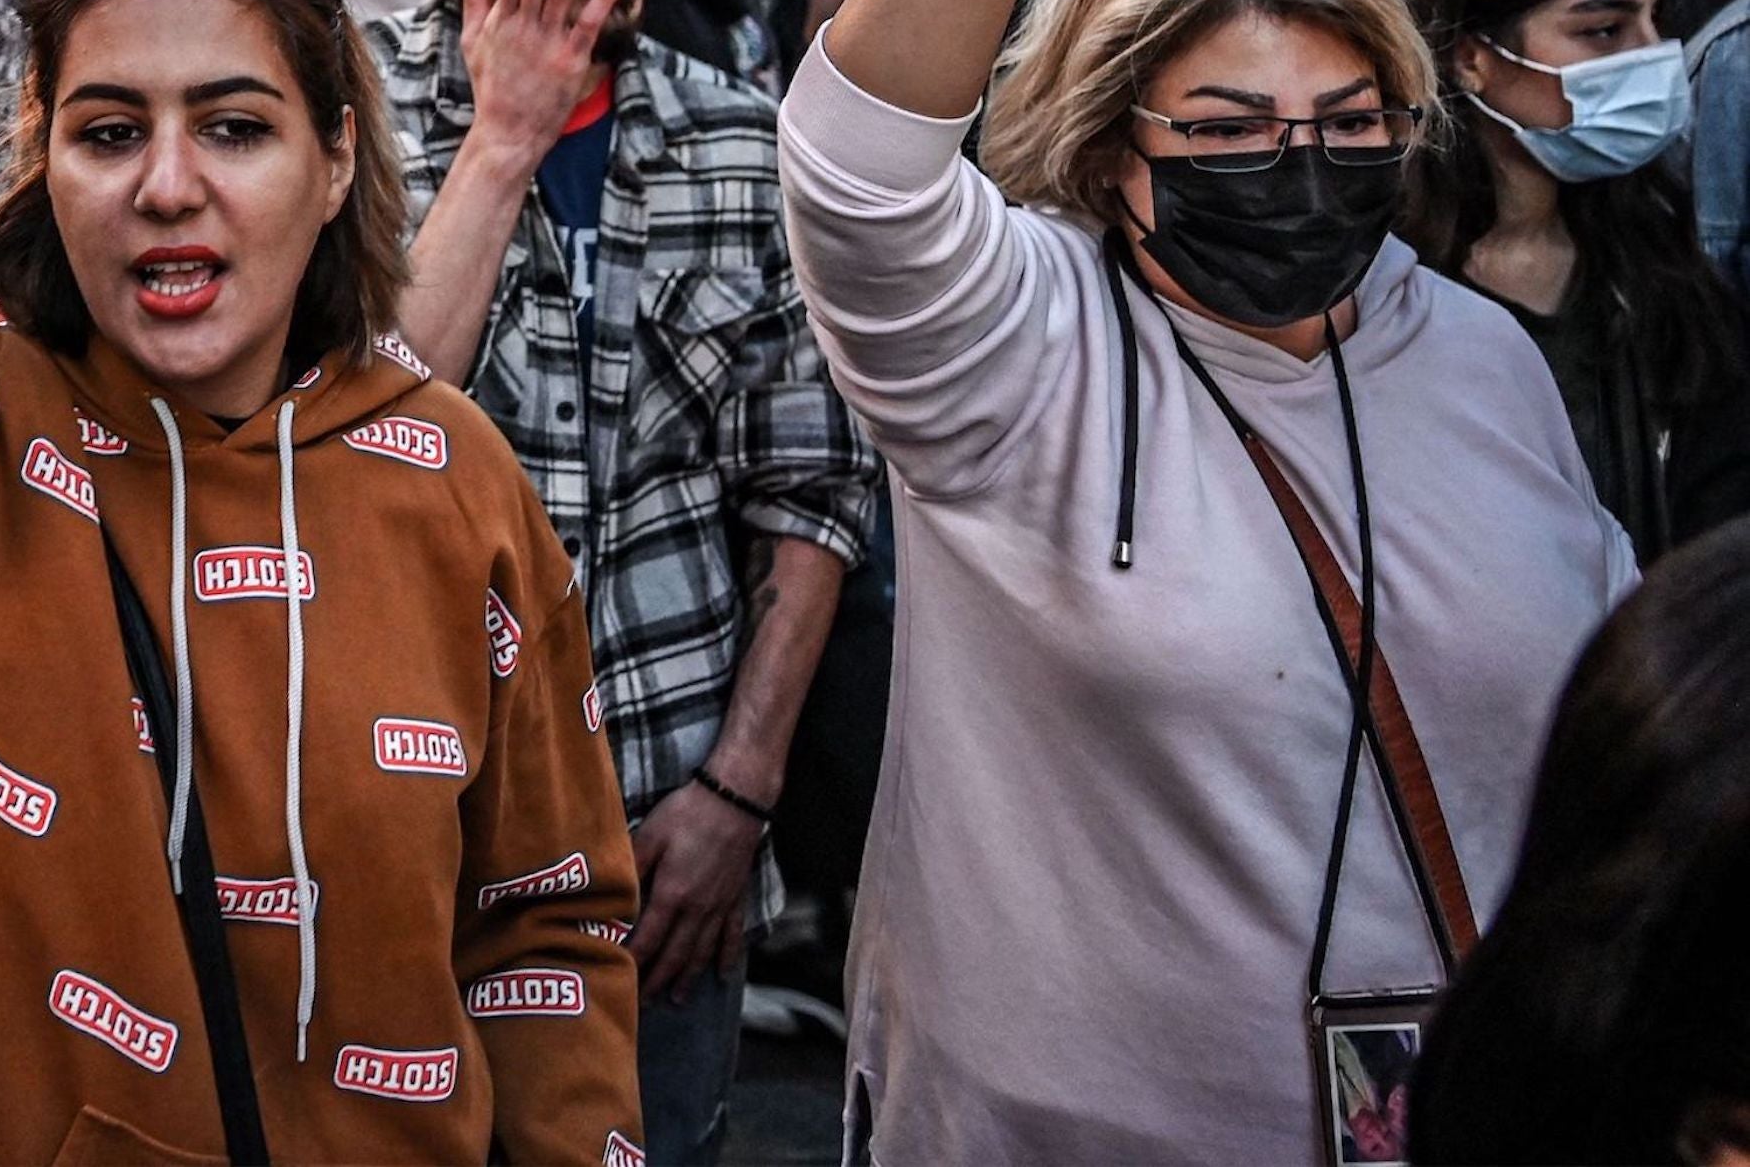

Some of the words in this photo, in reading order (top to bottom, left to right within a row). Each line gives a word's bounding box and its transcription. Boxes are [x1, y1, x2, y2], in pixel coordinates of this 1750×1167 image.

[32, 450, 94, 506] OTCH
[484, 609, 519, 668] SCO
[383, 730, 462, 765] SCOTCH
[218, 887, 301, 915] COTC
[479, 980, 576, 1009] SCOTCH
[61, 982, 166, 1059] SCOTCH
[346, 1055, 451, 1092] SCOTCH
